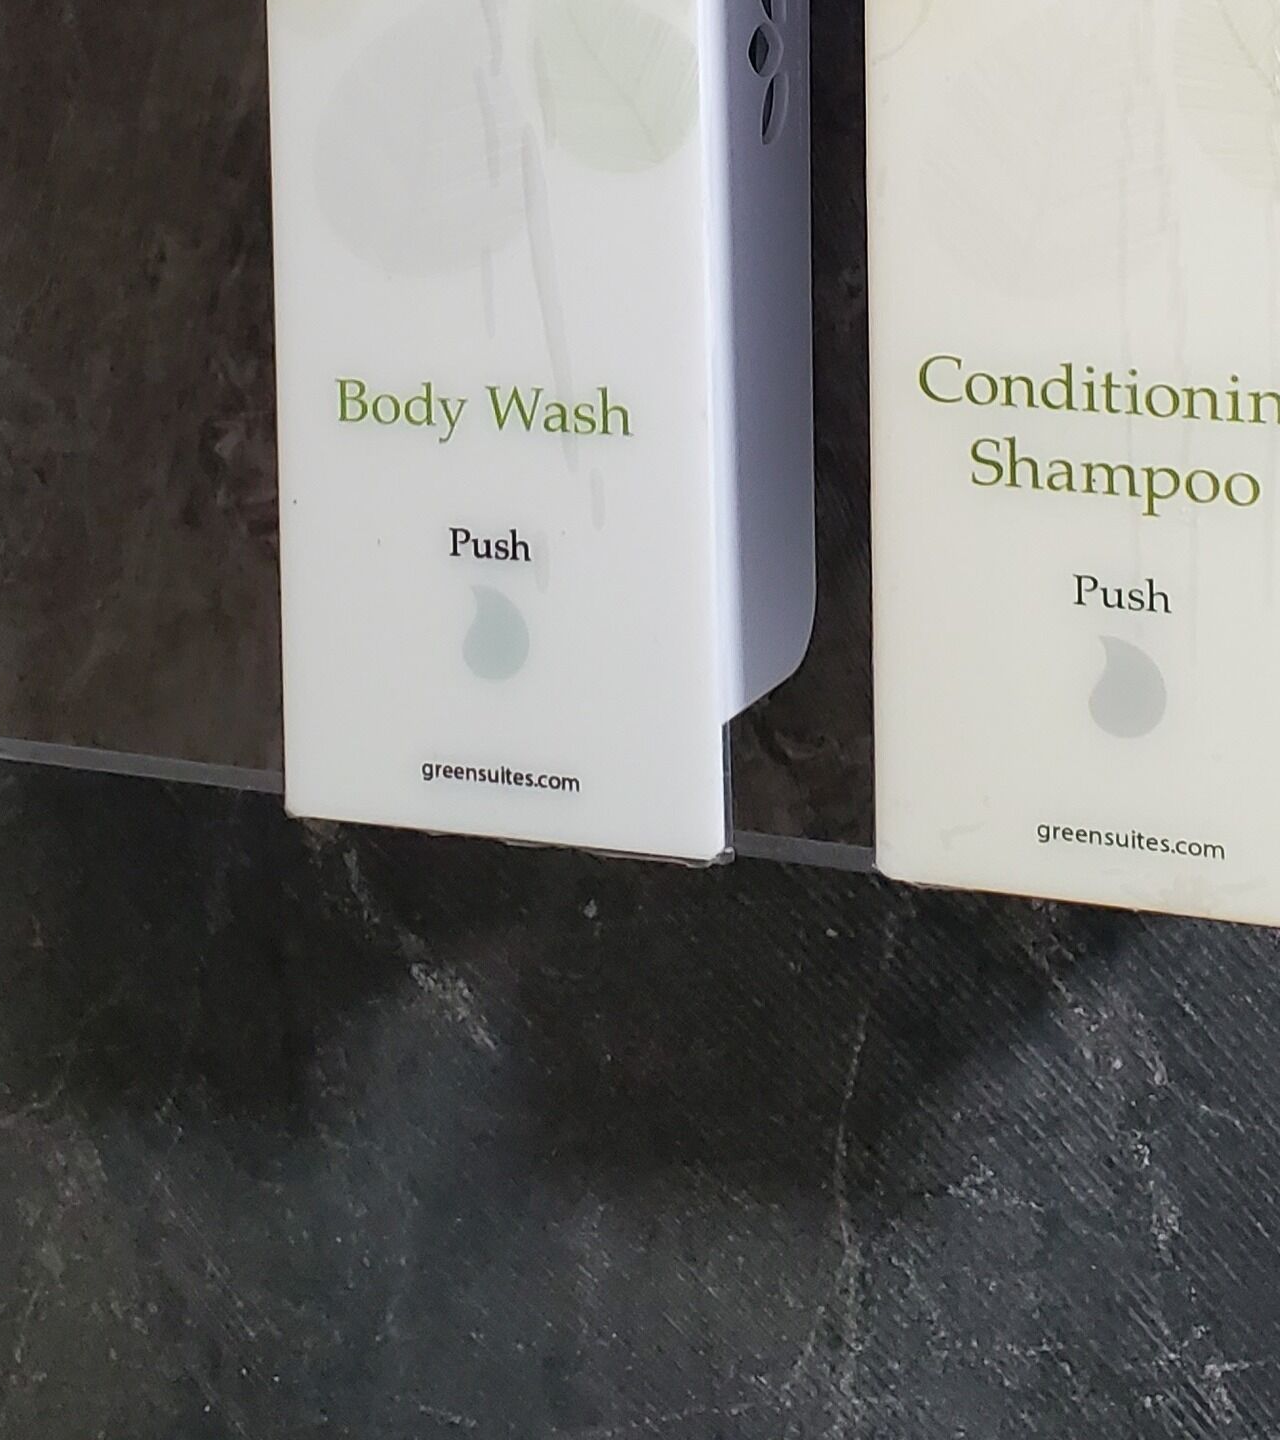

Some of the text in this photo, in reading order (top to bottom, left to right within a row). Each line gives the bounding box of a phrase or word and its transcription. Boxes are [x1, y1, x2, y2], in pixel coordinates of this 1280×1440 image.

[335, 377, 634, 444] Body Wash
[968, 436, 1262, 518] Shampoo
[448, 527, 532, 562] Push
[1072, 573, 1173, 615] Push
[420, 760, 581, 793] greensuites.com
[1035, 820, 1226, 861] greensuites.com
